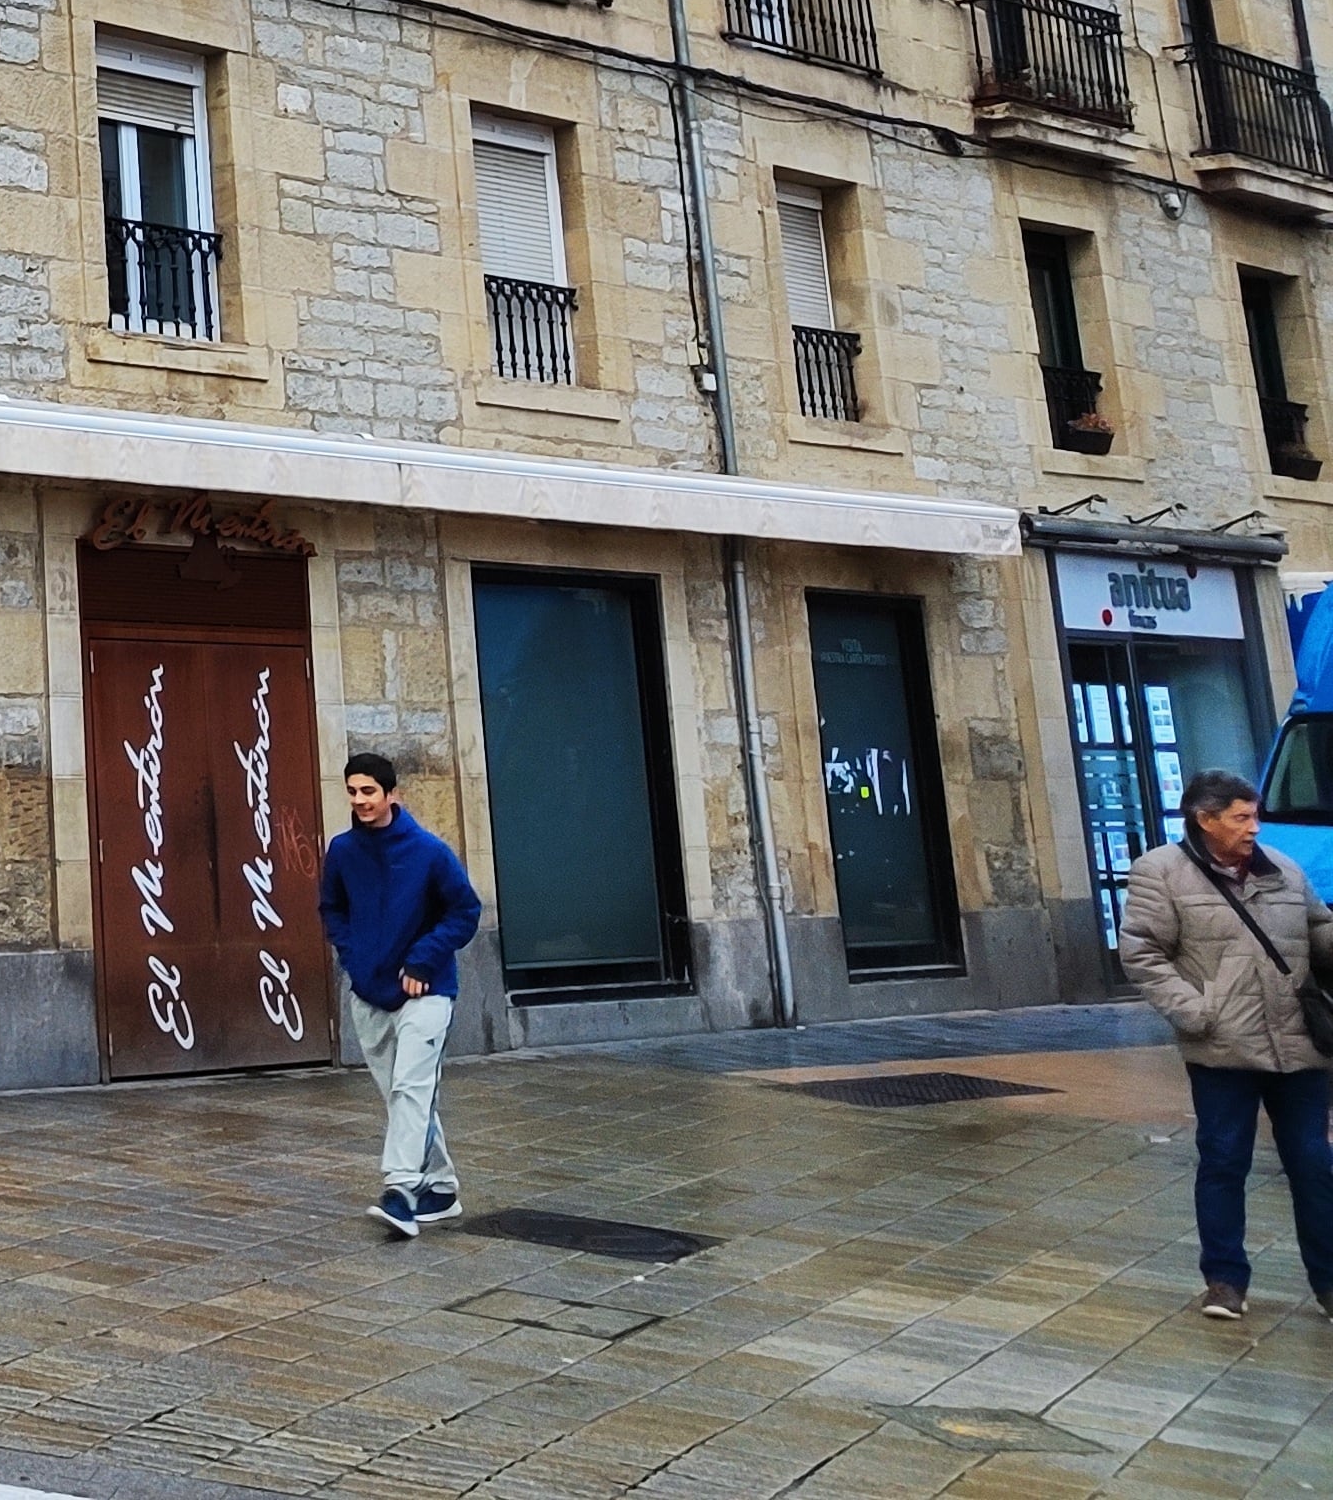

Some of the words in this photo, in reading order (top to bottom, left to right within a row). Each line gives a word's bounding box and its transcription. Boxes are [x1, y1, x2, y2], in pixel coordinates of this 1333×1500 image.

[93, 499, 150, 550] El
[1107, 561, 1192, 613] anitua
[124, 662, 175, 937] Mentirón
[233, 665, 284, 932] Mentirón
[147, 954, 195, 1051] El
[258, 949, 304, 1042] El
